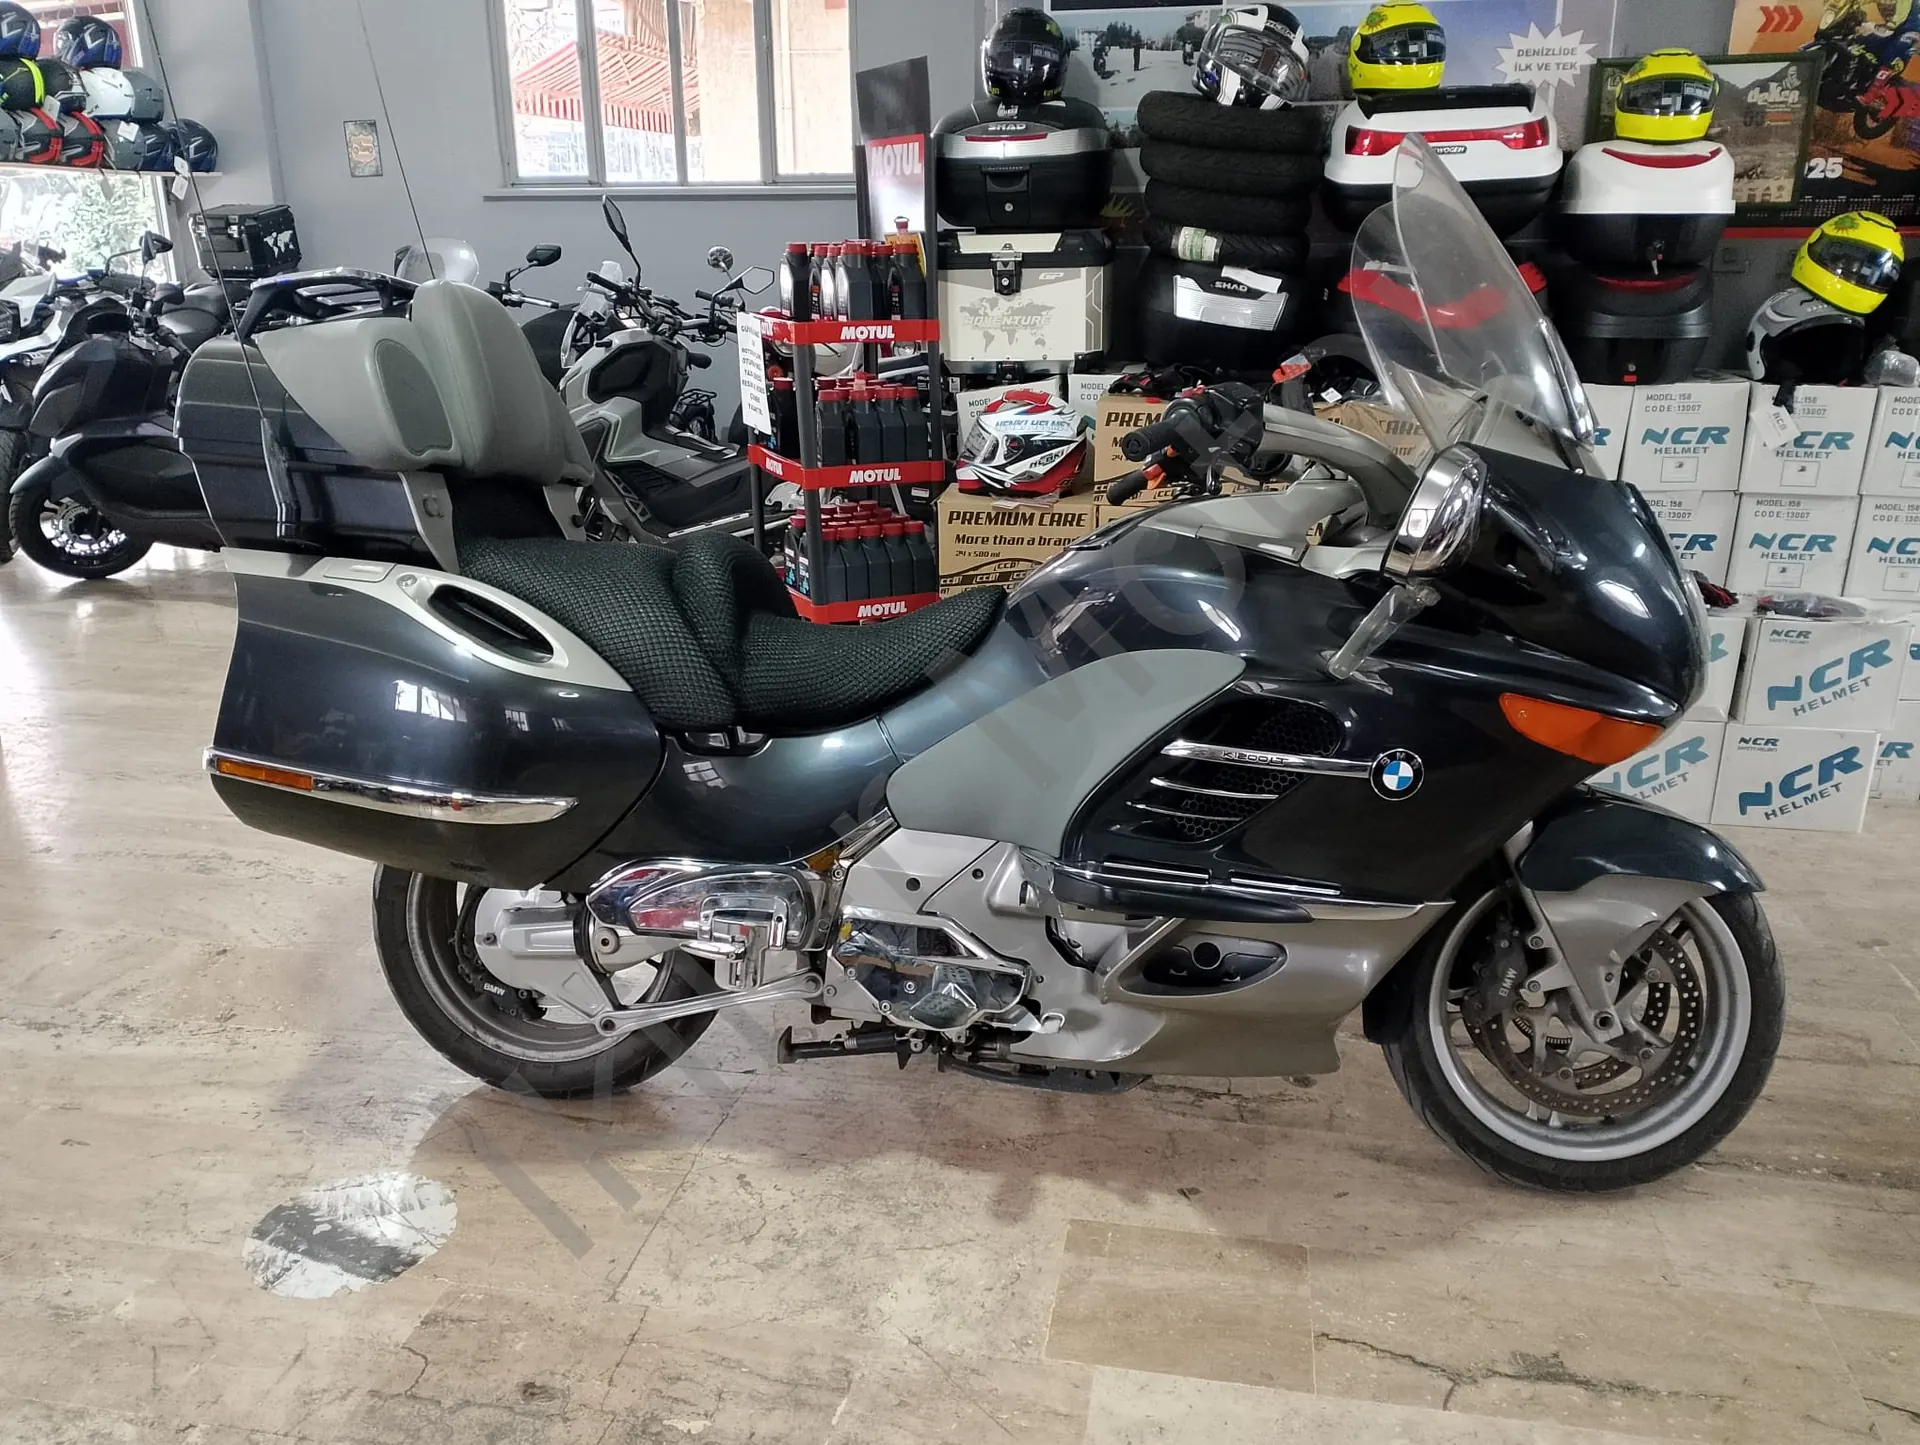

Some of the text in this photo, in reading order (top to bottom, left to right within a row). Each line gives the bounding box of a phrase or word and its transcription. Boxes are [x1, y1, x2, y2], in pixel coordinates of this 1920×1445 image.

[1516, 46, 1577, 57] DENİZLİDE
[1513, 61, 1578, 72] İLK VE TEK
[987, 123, 1027, 131] SHAD
[870, 142, 923, 177] MOTUL
[1213, 281, 1248, 292] SHAD
[840, 325, 895, 341] MOTUL
[1105, 412, 1162, 427] PREM
[1641, 426, 1731, 445] NCR
[1653, 446, 1710, 455] HELMET
[1775, 450, 1833, 459] HELMET
[765, 457, 783, 476] MOTUL
[849, 468, 902, 484] MOTUL
[947, 510, 1089, 528] PREMIUM CARE
[955, 534, 990, 545] More
[993, 534, 1024, 546] than
[1026, 538, 1036, 546] a
[1749, 533, 1838, 553] NCR
[1866, 536, 1920, 555] NC
[1760, 552, 1817, 561] HELMET
[857, 601, 907, 618] MOTUL
[1770, 629, 1813, 640] NCR
[1767, 639, 1894, 711] NCR
[1792, 676, 1873, 717] HELMET
[1738, 736, 1780, 747] NCR
[1738, 746, 1864, 816] NCR
[1764, 782, 1844, 821] HELMET
[483, 982, 506, 997] BMW
[1499, 967, 1519, 998] BMW
